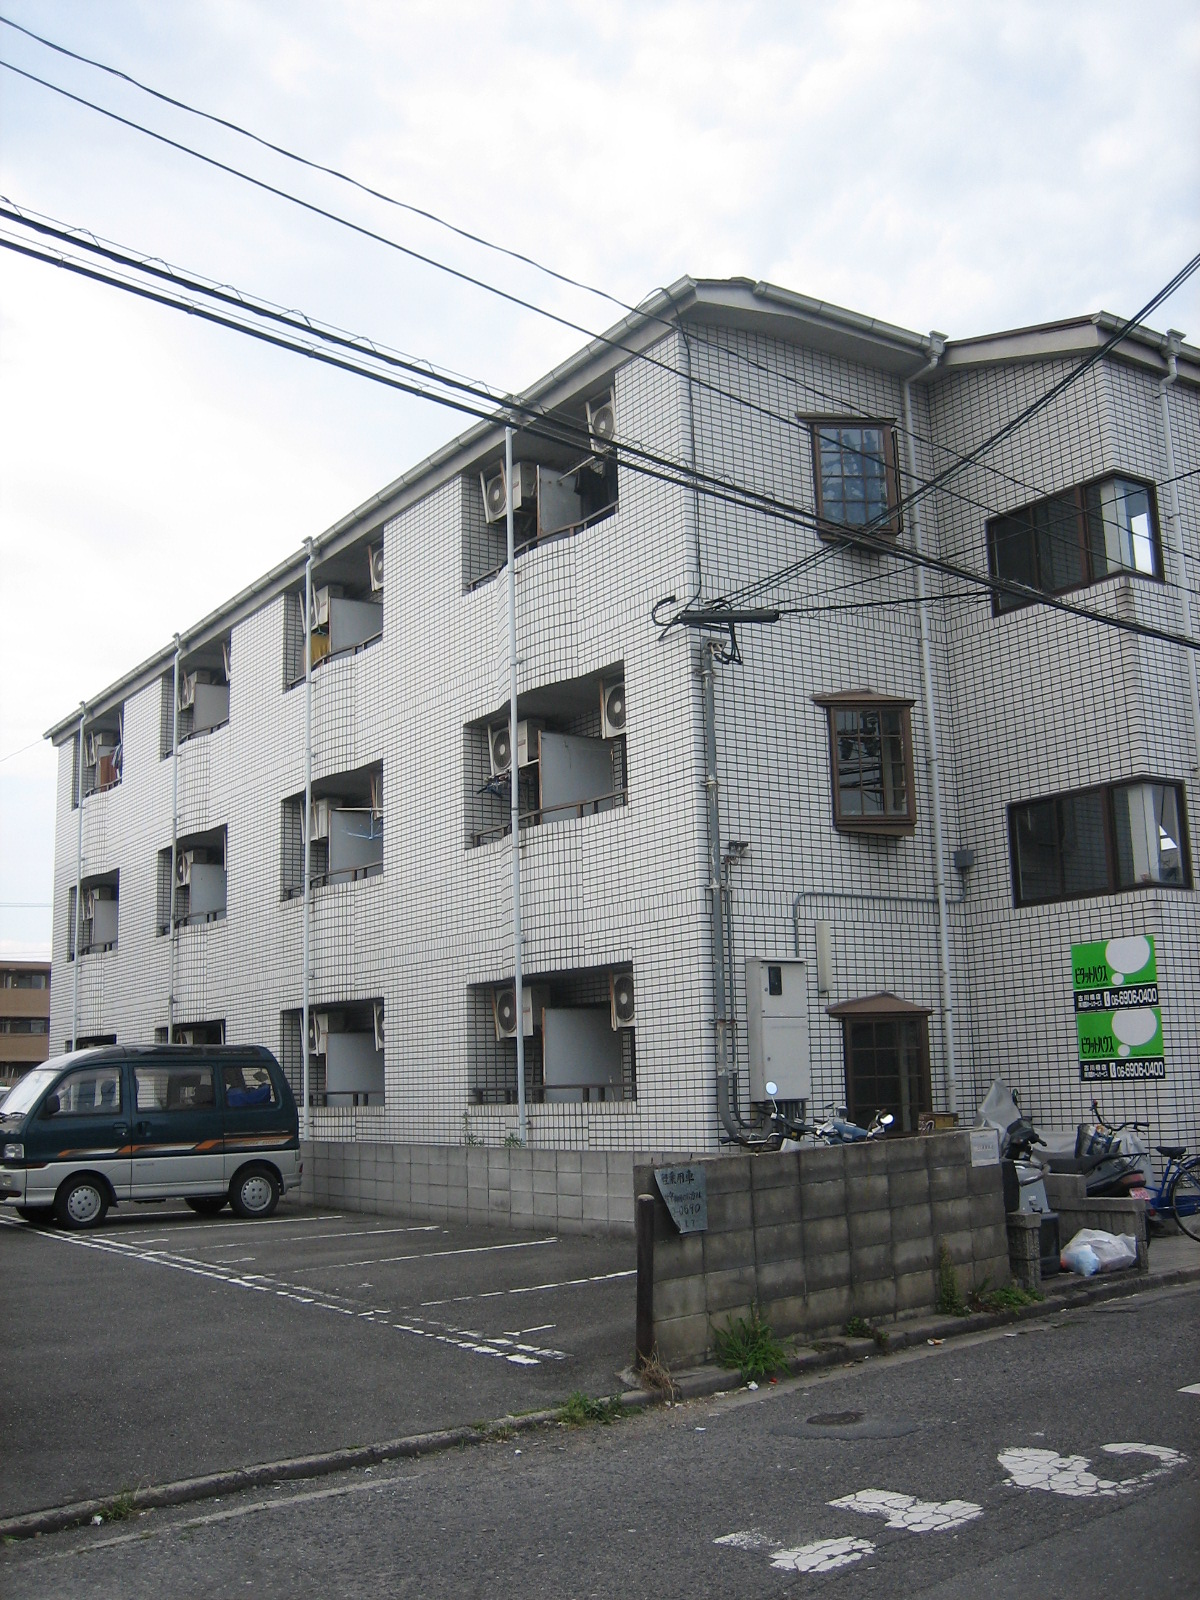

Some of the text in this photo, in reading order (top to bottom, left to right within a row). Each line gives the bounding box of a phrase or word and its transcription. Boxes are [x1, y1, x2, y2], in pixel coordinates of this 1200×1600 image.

[1075, 965, 1108, 984] ピタットハウス
[1111, 988, 1157, 1006] 06-6906-0400
[1081, 1035, 1114, 1053] ピタットハウス
[1116, 1061, 1164, 1078] 06-6906-0400
